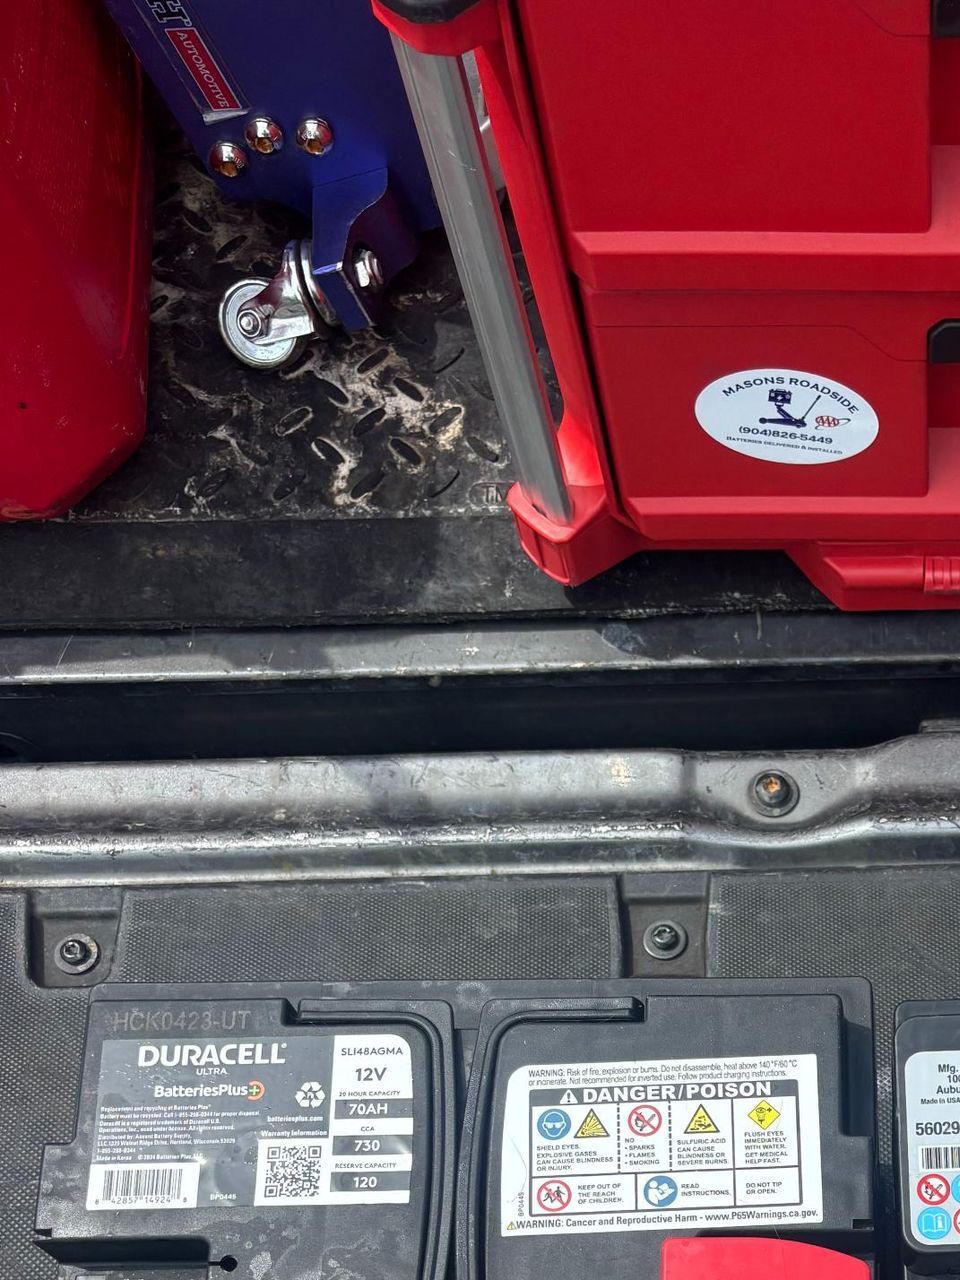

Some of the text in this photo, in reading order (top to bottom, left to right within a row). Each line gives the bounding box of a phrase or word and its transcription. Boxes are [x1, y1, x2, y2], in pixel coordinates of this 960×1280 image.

[176, 31, 229, 107] AUTOMOTIVE
[722, 377, 859, 414] MASONS ROADSIDE
[817, 416, 839, 427] AAA
[739, 426, 833, 444] (904)826-5449
[111, 1010, 251, 1031] HCK0423-UT
[137, 1043, 286, 1066] DURACELL
[341, 1047, 403, 1056] SLI48AGMA
[354, 1068, 386, 1081] 12V
[937, 1063, 959, 1074] Mfg.
[154, 1084, 248, 1098] BatteriesPlus
[338, 1089, 400, 1098] 20 HOUR CAPACITY
[583, 1081, 772, 1103] DANGER/POISON
[349, 1103, 388, 1115] 70AH
[267, 1114, 323, 1122] batteriesplus.com
[261, 1129, 289, 1137] Warranty
[915, 1121, 960, 1136] 56029
[354, 1139, 380, 1151] 730
[353, 1176, 377, 1189] 120
[681, 1189, 731, 1197] INSTRUCTIONS.
[516, 1218, 564, 1230] WARNING:
[565, 1218, 596, 1227] Cancer
[598, 1216, 614, 1225] and
[616, 1214, 672, 1226] Reproductive
[674, 1213, 697, 1222] Harm
[704, 1209, 818, 1221] www.P65Warnings.ca.gov.
